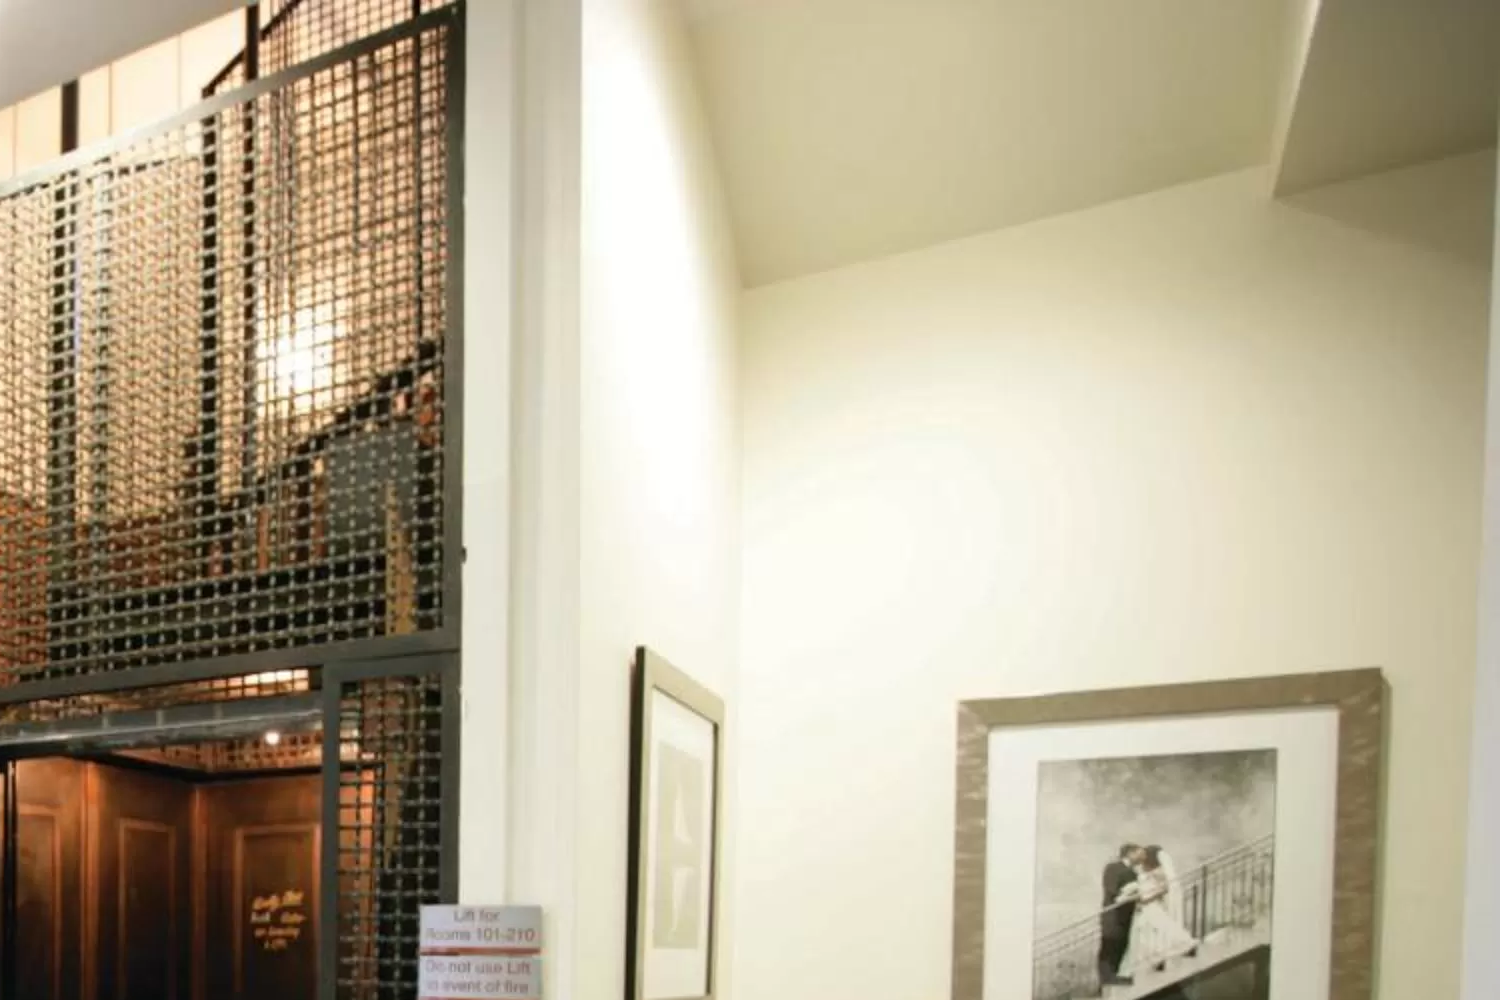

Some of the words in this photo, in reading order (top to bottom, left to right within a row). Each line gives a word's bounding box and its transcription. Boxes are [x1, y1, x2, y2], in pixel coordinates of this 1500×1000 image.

[454, 909, 475, 923] Lift
[479, 909, 500, 923] for
[476, 927, 536, 942] 101-210
[425, 959, 445, 973] Do
[448, 961, 471, 974] not
[475, 963, 503, 975] use
[507, 961, 533, 975] Lift
[442, 980, 482, 993] event
[484, 980, 500, 993] of
[504, 980, 530, 994] fire
